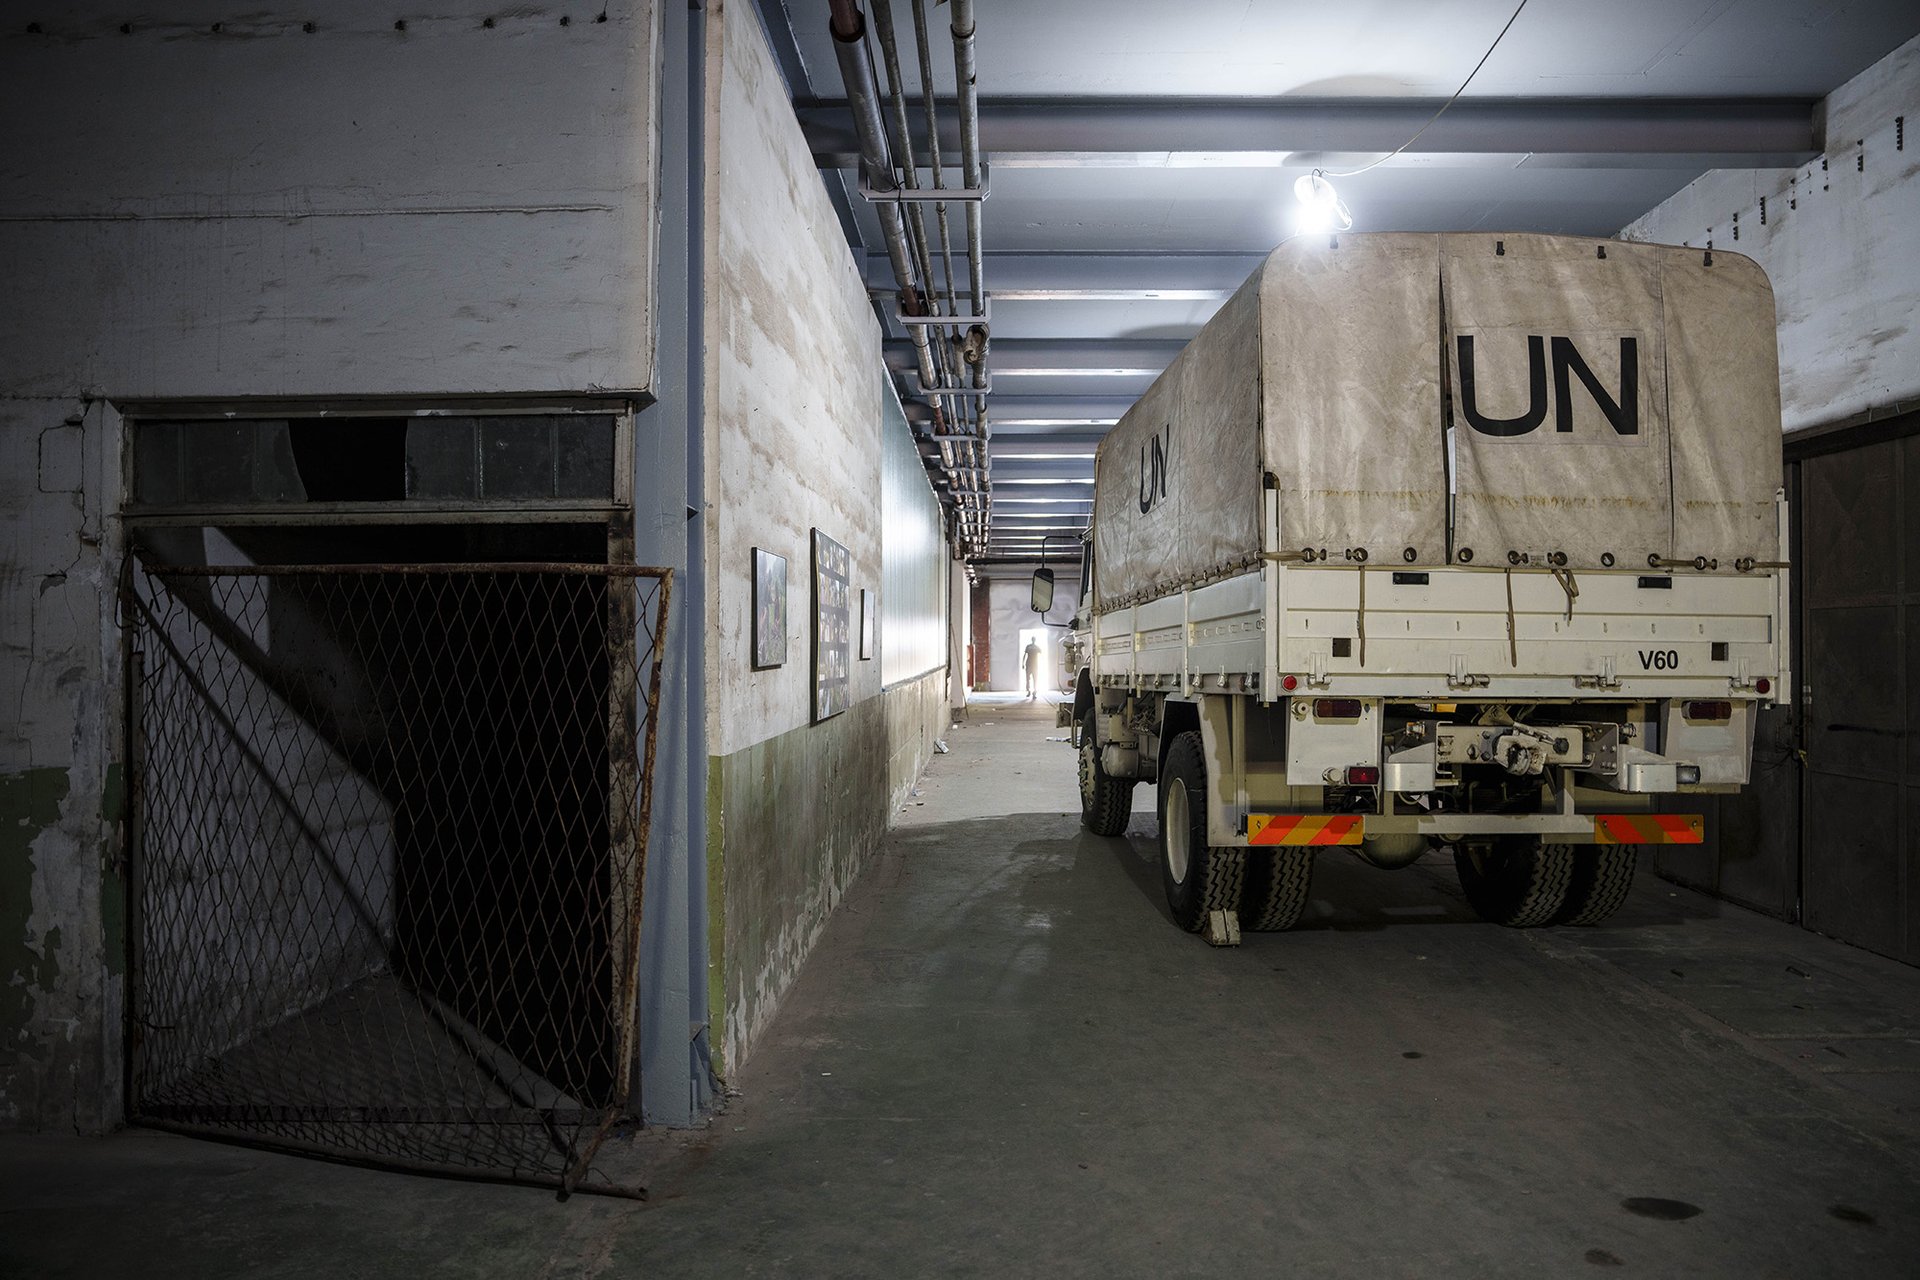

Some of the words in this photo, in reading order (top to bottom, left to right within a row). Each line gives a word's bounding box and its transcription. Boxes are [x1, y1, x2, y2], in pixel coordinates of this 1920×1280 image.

[1457, 335, 1639, 437] UN
[1139, 423, 1170, 515] UN
[1637, 649, 1680, 671] V60
